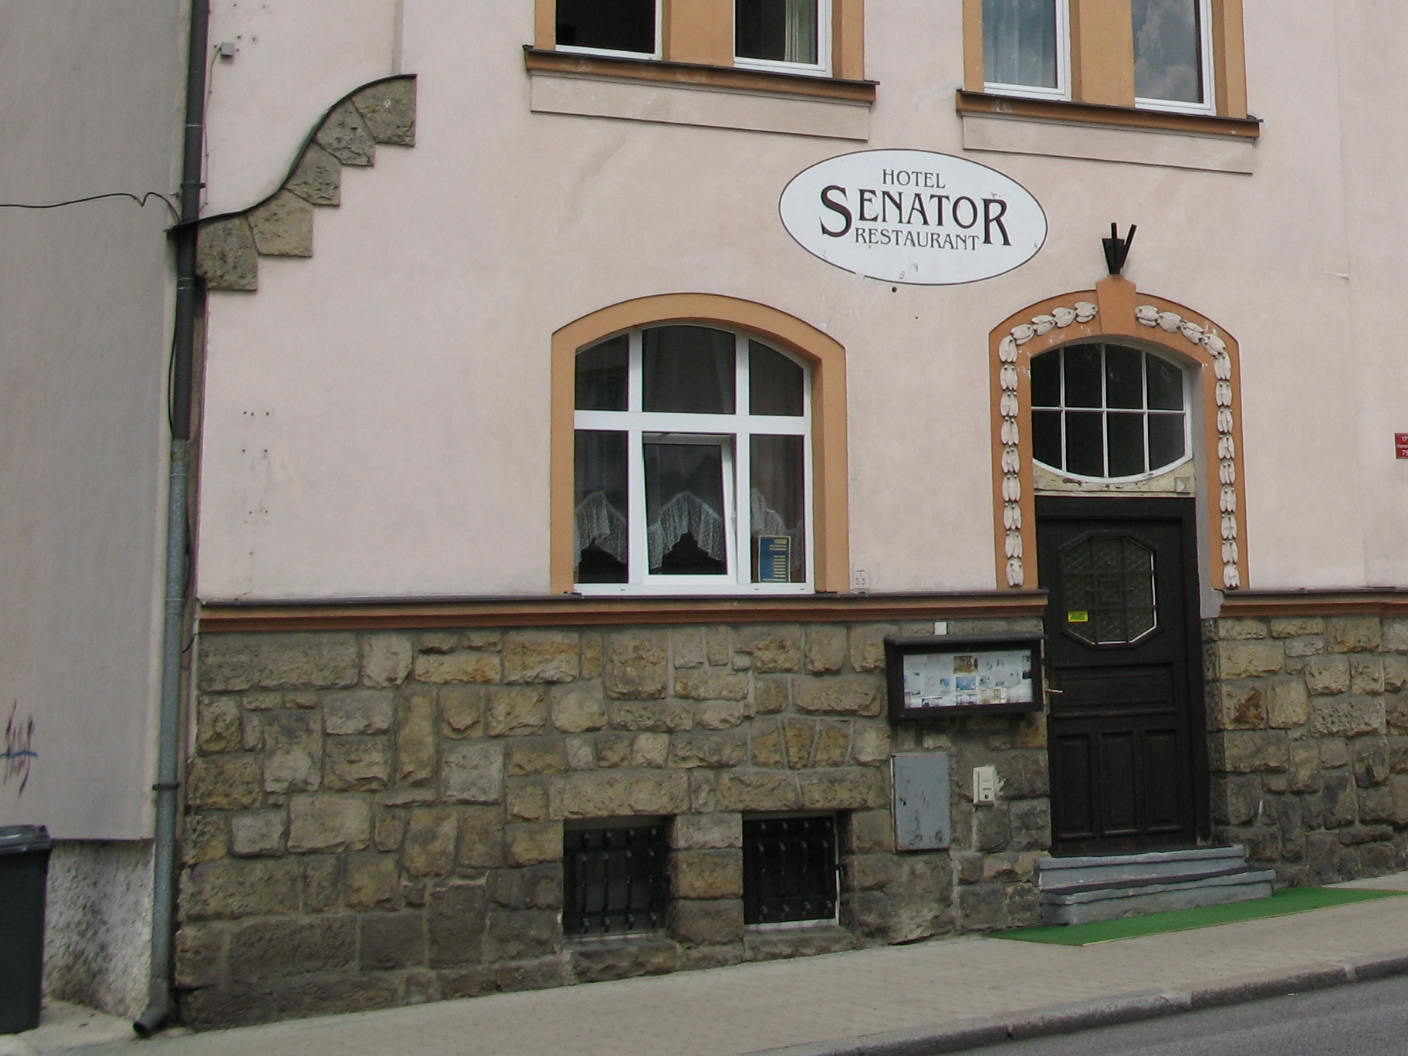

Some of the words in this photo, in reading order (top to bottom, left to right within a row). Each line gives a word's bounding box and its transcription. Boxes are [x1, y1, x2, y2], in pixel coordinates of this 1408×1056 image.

[882, 168, 947, 189] HOTEL
[819, 184, 1012, 246] SENATOR
[854, 227, 980, 251] RESTAURANT
